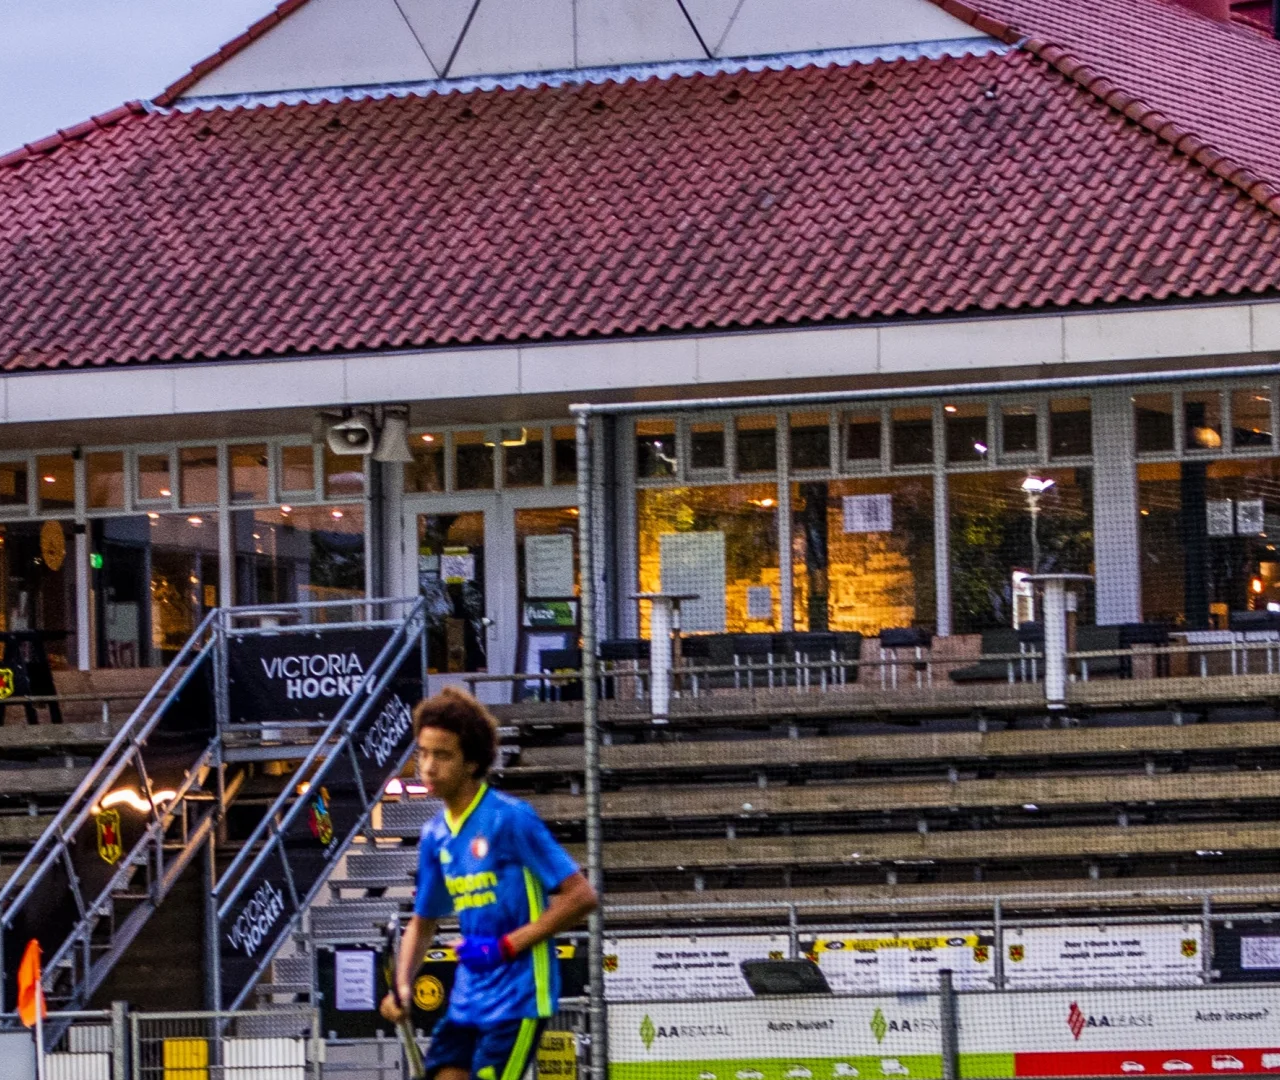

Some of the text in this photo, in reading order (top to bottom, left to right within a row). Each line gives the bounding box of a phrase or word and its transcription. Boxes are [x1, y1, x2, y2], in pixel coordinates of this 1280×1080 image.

[260, 653, 364, 680] VICTORIA
[375, 702, 413, 768] HOCKEY
[242, 887, 285, 958] HOCKEY
